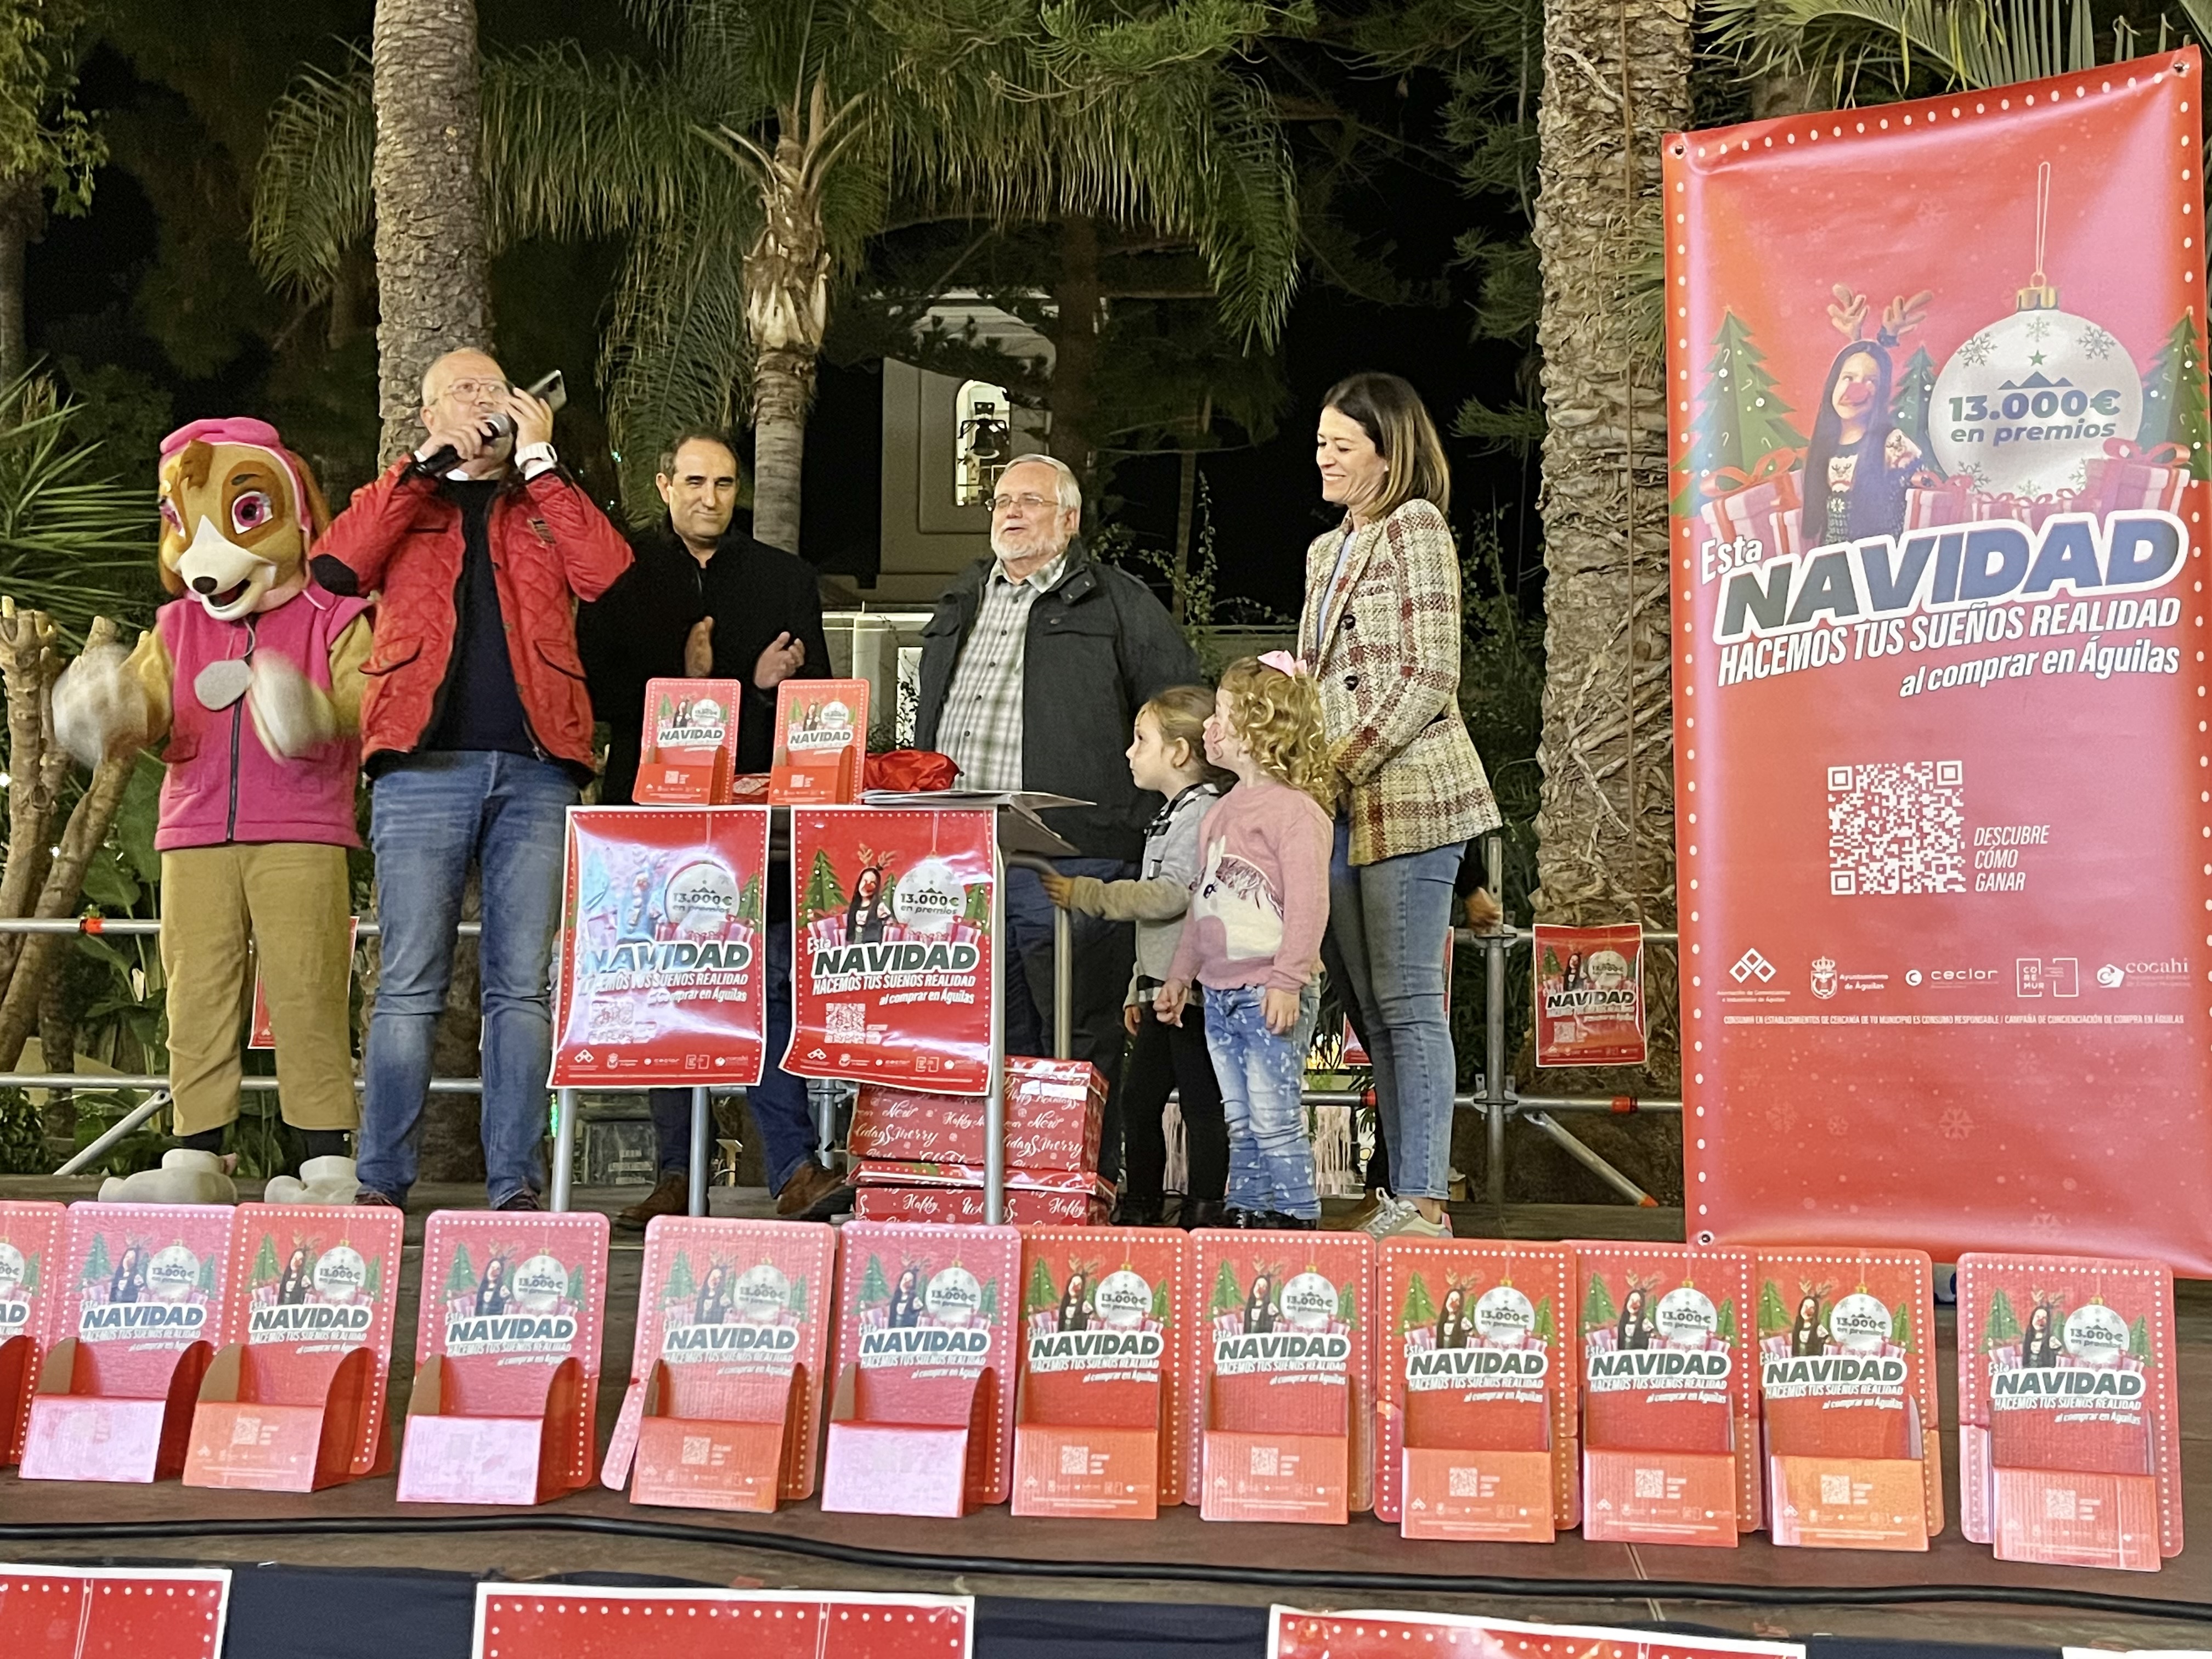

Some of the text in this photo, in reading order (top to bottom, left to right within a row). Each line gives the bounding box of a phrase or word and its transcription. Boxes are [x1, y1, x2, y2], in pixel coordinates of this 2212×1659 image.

[1949, 390, 2121, 422] 13.000€
[1951, 420, 2115, 447] en premios
[1701, 537, 1763, 584] Esta
[1718, 515, 2183, 639] NAVIDAD
[1718, 598, 2181, 687] HACEMOS TUS SUEÑOS REALIDAD
[1899, 636, 2180, 698] al comprar en Águilas
[660, 729, 723, 740] NAVIDAD
[790, 732, 851, 744] NAVIDAD
[1974, 825, 2050, 846] DESCUBRE
[1974, 846, 2018, 869] CÓMO
[1975, 872, 2025, 891] GANAR
[673, 894, 732, 906] 13.000€
[901, 894, 959, 906] 13.000€
[915, 906, 957, 915] premios
[807, 937, 832, 955] Esta
[582, 944, 749, 973] NAVIDAD
[814, 945, 977, 976] NAVIDAD
[2125, 957, 2188, 973] cocahi
[696, 974, 749, 985] REALIDAD
[812, 977, 862, 996] HACEMOS
[863, 975, 882, 990] TUS
[925, 974, 976, 988] REALIDAD
[1931, 968, 1998, 981] ceclor
[699, 991, 710, 1000] en
[712, 987, 747, 1003] Águilas
[879, 988, 974, 1006] al comprar en Águilas
[1547, 991, 1634, 1008] NAVIDAD
[83, 1306, 203, 1329] NAVIDAD
[252, 1308, 369, 1330] NAVIDAD
[1837, 1317, 1886, 1329] 13.000€
[449, 1318, 573, 1342] NAVIDAD
[667, 1328, 795, 1350] NAVIDAD
[2070, 1329, 2123, 1342] 13.000€
[863, 1331, 987, 1354] NAVIDAD
[1032, 1334, 1159, 1358] NAVIDAD
[1218, 1336, 1347, 1360] NAVIDAD
[1410, 1352, 1543, 1375] NAVIDAD
[1592, 1353, 1727, 1376] NAVIDAD
[1767, 1359, 1903, 1384] NAVIDAD
[1995, 1372, 2141, 1395] NAVIDAD
[1994, 1398, 2038, 1411] HACEMOS
[2039, 1398, 2056, 1409] TUS
[2096, 1398, 2142, 1410] REALIDAD
